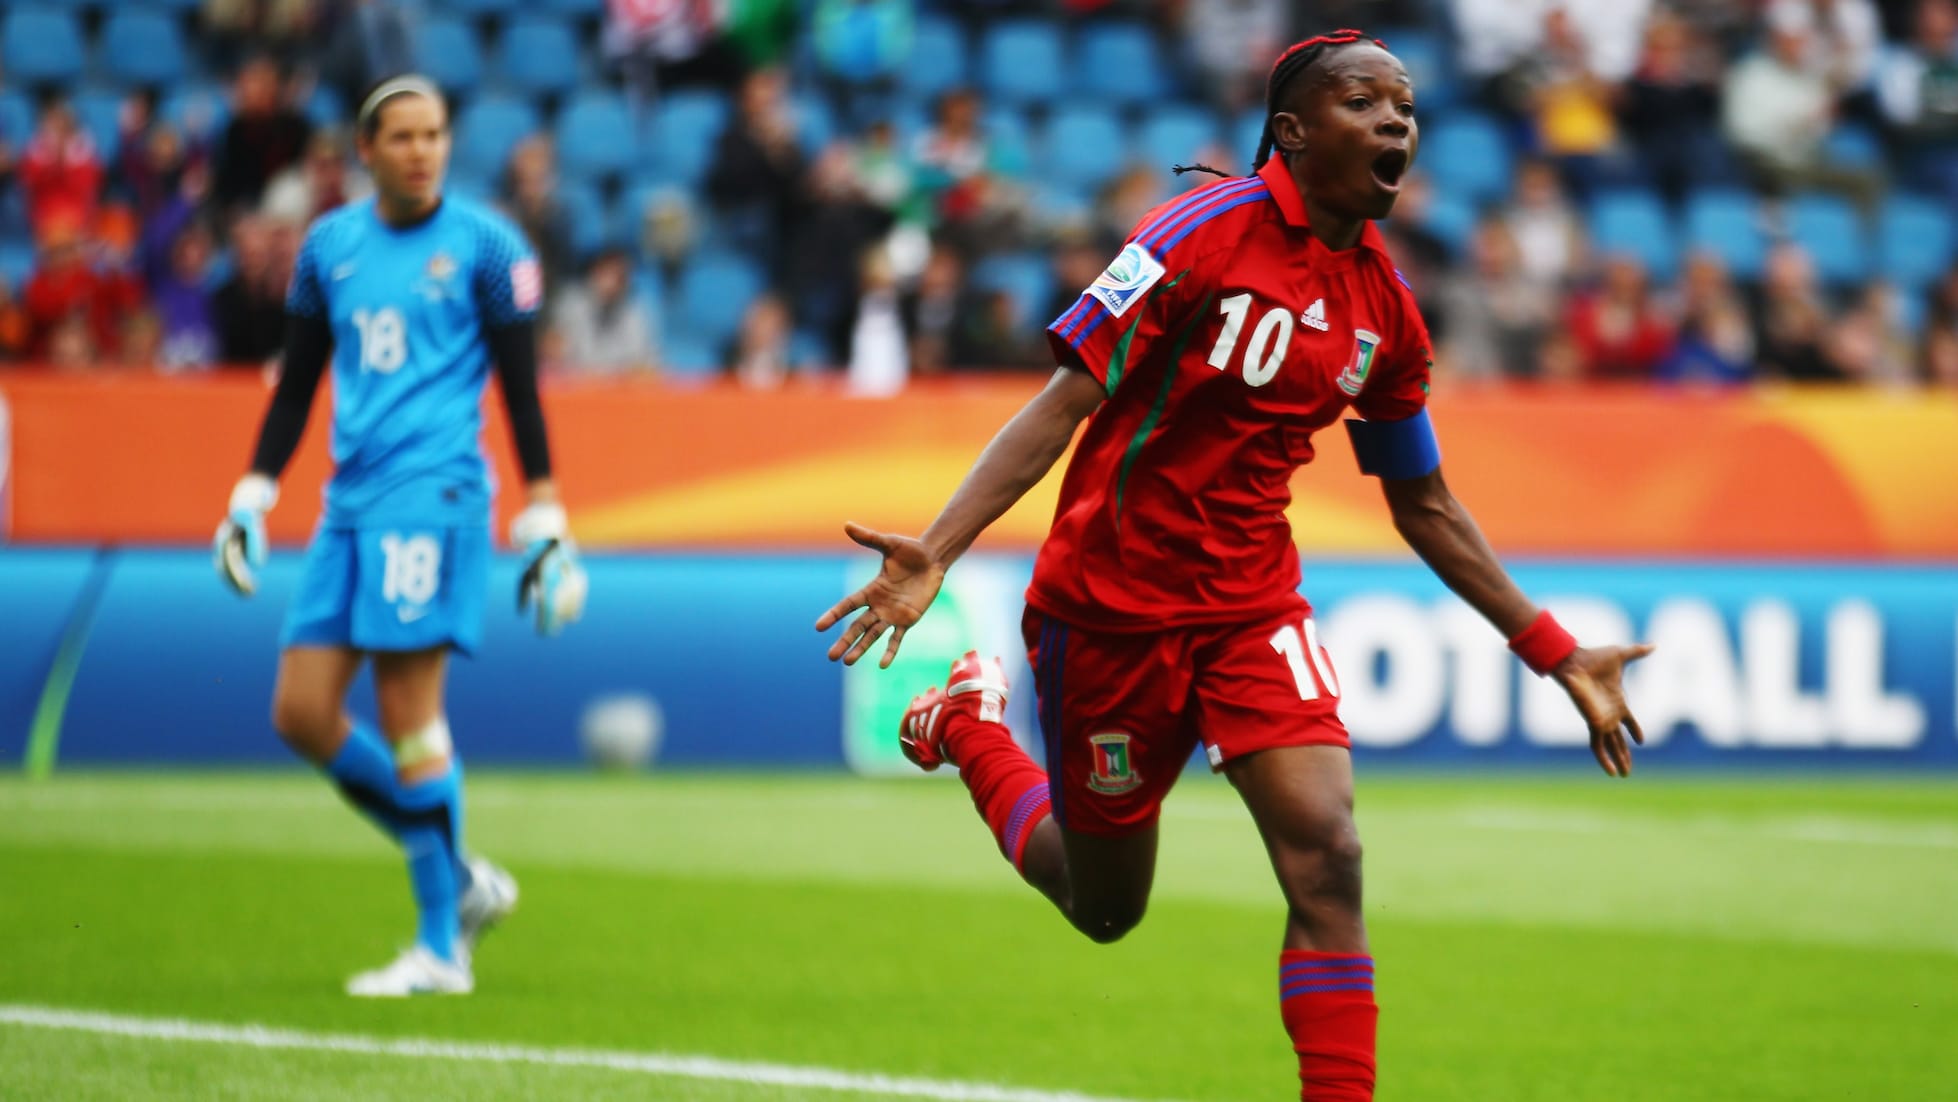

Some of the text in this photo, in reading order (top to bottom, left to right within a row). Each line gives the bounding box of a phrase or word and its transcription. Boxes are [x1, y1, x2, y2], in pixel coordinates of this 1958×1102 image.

[352, 307, 407, 374] 18
[1207, 292, 1293, 388] 10
[380, 533, 441, 604] 18
[1320, 594, 1926, 748] OTBALL
